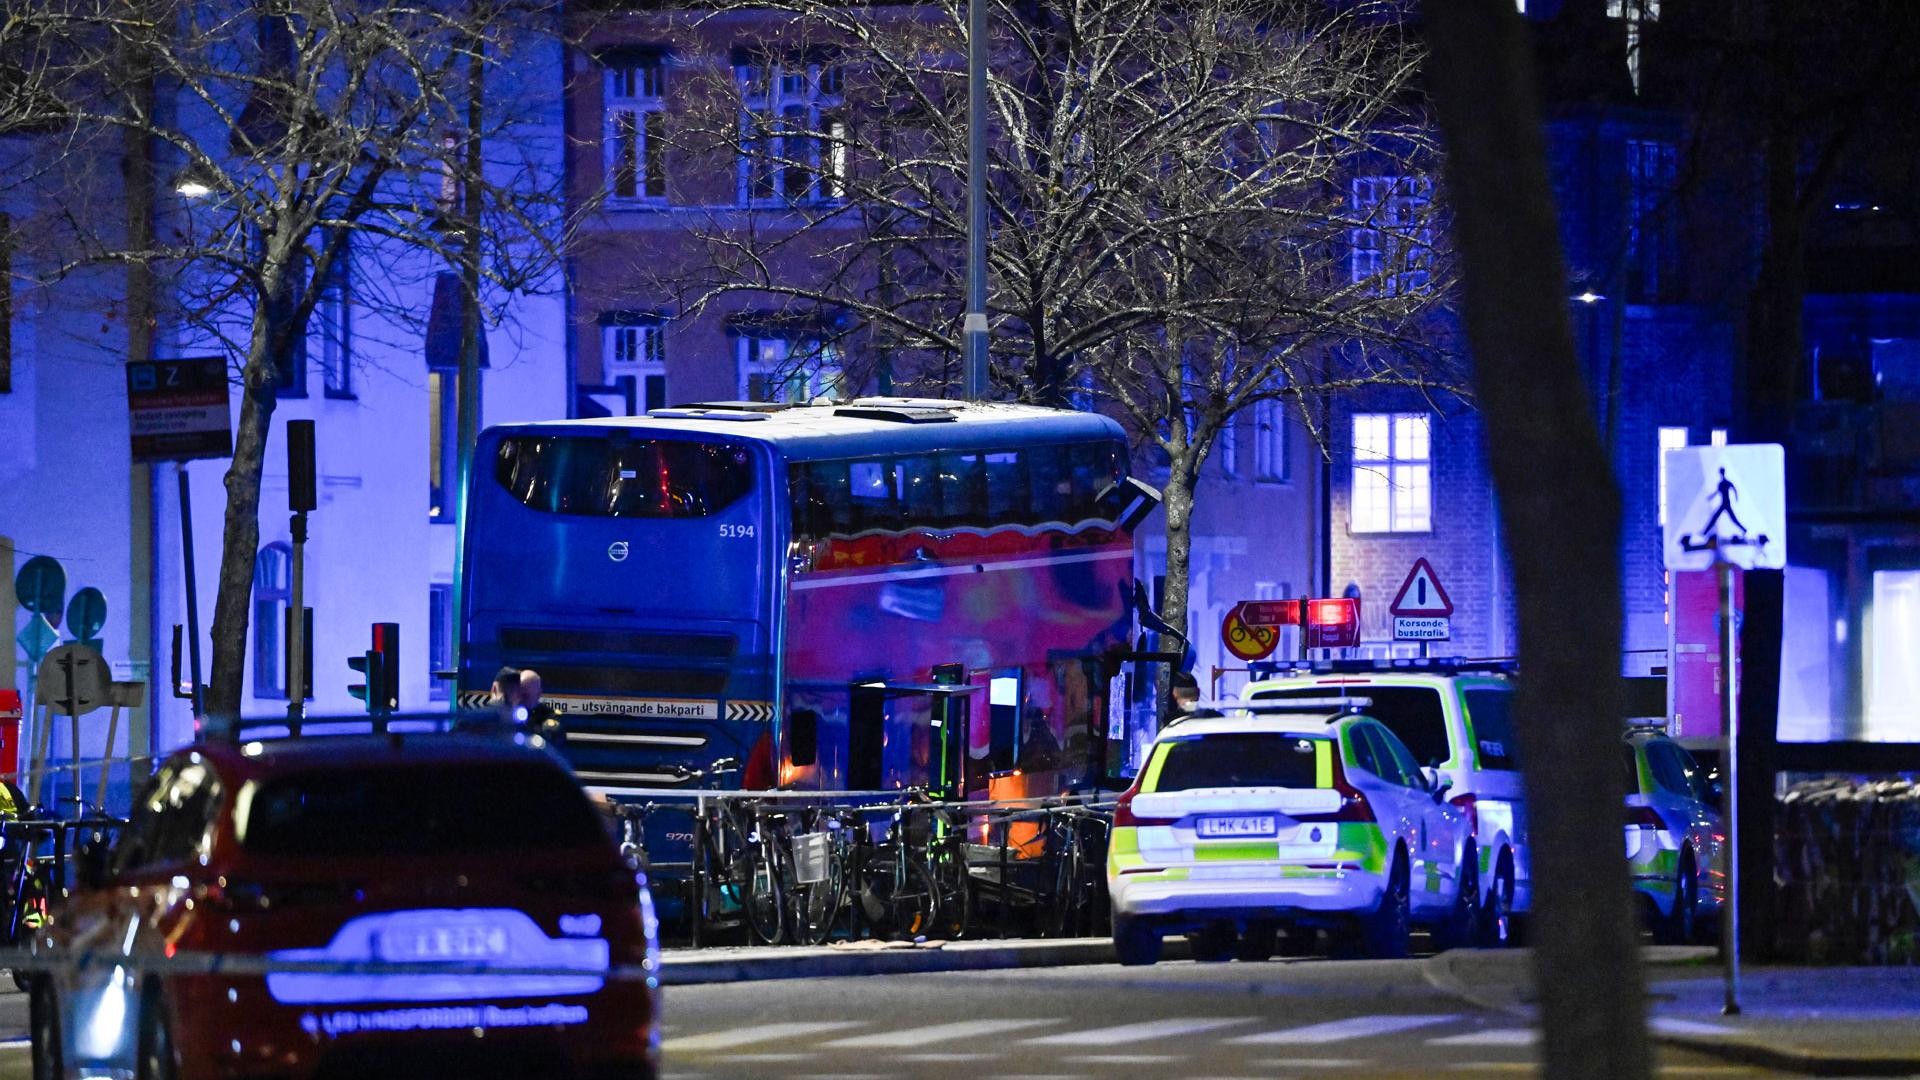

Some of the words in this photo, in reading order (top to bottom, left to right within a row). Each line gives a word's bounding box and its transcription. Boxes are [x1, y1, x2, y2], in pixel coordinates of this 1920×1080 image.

[165, 367, 179, 386] Z
[719, 524, 755, 538] 5194
[1399, 619, 1444, 628] Korsande
[1398, 629, 1444, 637] busstrafik
[544, 700, 568, 713] ning
[582, 701, 653, 715] utsvängande
[657, 703, 705, 717] bakparti
[1209, 818, 1235, 833] LMK
[665, 832, 694, 842] 970
